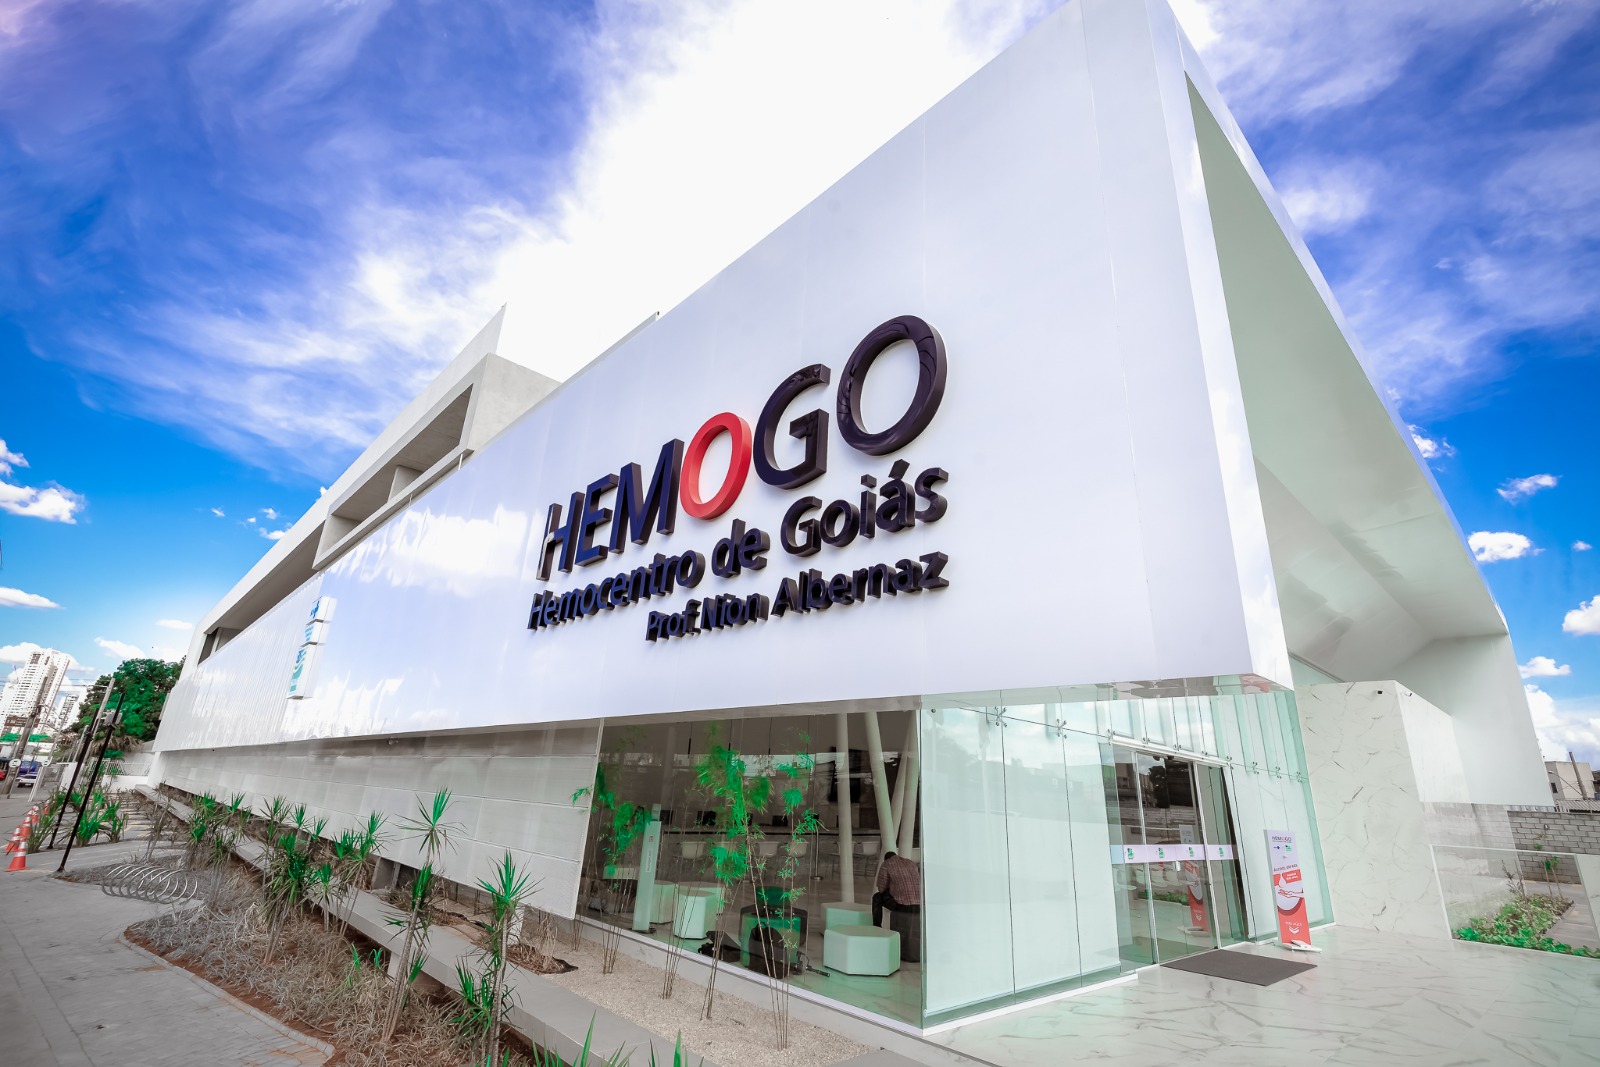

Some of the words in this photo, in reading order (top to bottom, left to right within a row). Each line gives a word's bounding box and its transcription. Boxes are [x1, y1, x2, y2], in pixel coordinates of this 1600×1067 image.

[535, 315, 948, 581] HEMOGO
[527, 549, 706, 630] Hemocentro
[711, 518, 770, 578] de
[780, 458, 949, 557] Goiás
[645, 599, 702, 642] Prof.
[700, 592, 770, 631] Nion
[771, 551, 950, 617] Albernaz
